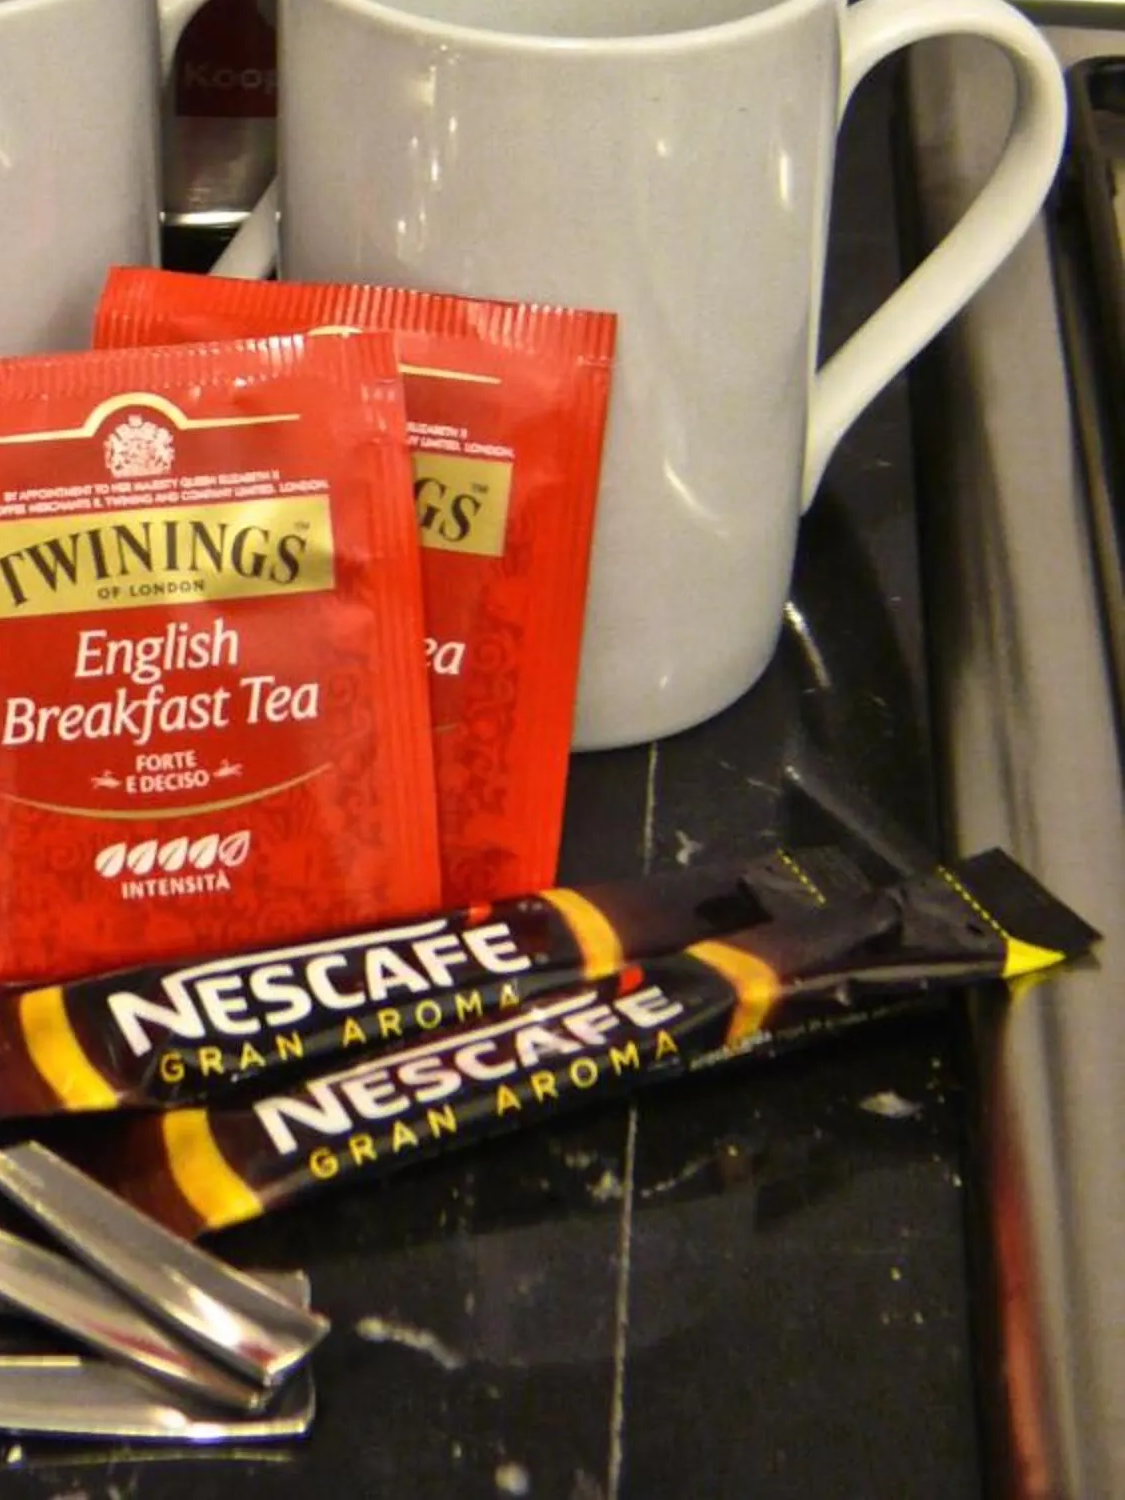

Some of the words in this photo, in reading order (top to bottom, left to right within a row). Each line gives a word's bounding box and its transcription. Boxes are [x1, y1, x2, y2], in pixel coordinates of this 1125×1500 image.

[97, 585, 121, 601] OF
[129, 579, 206, 598] LONDON
[74, 617, 239, 685] English
[0, 686, 230, 746] Breakfast
[239, 675, 320, 724] Tea
[125, 775, 137, 794] E
[139, 769, 210, 793] DECISO
[135, 750, 196, 772] FORTE
[121, 868, 231, 899] INTENSITÀ
[159, 1031, 305, 1083] GRAN
[342, 979, 521, 1047] AROMA
[309, 1104, 459, 1180] GRAN
[495, 1029, 679, 1117] AROMA
